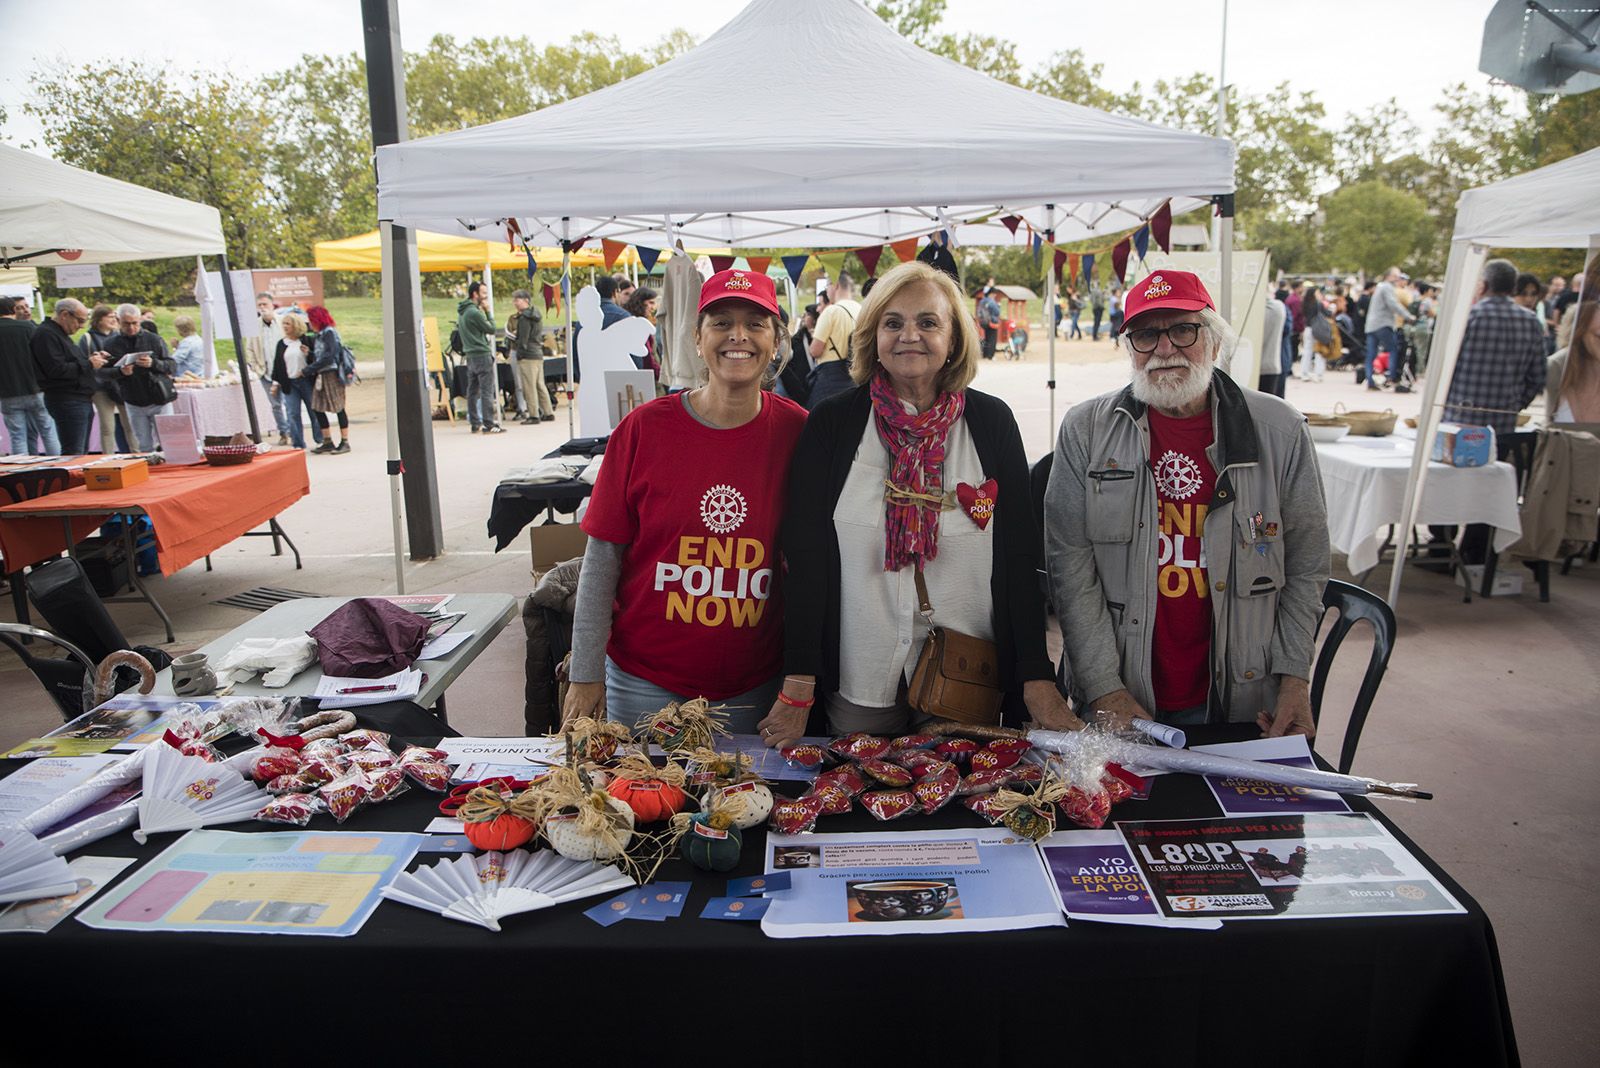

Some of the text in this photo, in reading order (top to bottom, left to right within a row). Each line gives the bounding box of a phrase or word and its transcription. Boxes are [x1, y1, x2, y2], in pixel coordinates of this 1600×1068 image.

[1144, 285, 1172, 297] POLIO
[1147, 290, 1169, 300] NOW
[975, 498, 993, 507] END
[678, 535, 765, 569] END
[654, 561, 773, 600] POLIO
[665, 592, 767, 628] NOW
[1235, 786, 1313, 796] POLIO
[776, 806, 807, 815] POLIO
[1098, 857, 1126, 866] YO
[1148, 863, 1245, 873] LOS 80 PRINCIPALES
[1083, 885, 1109, 893] LA
[1349, 889, 1396, 898] Rotary
